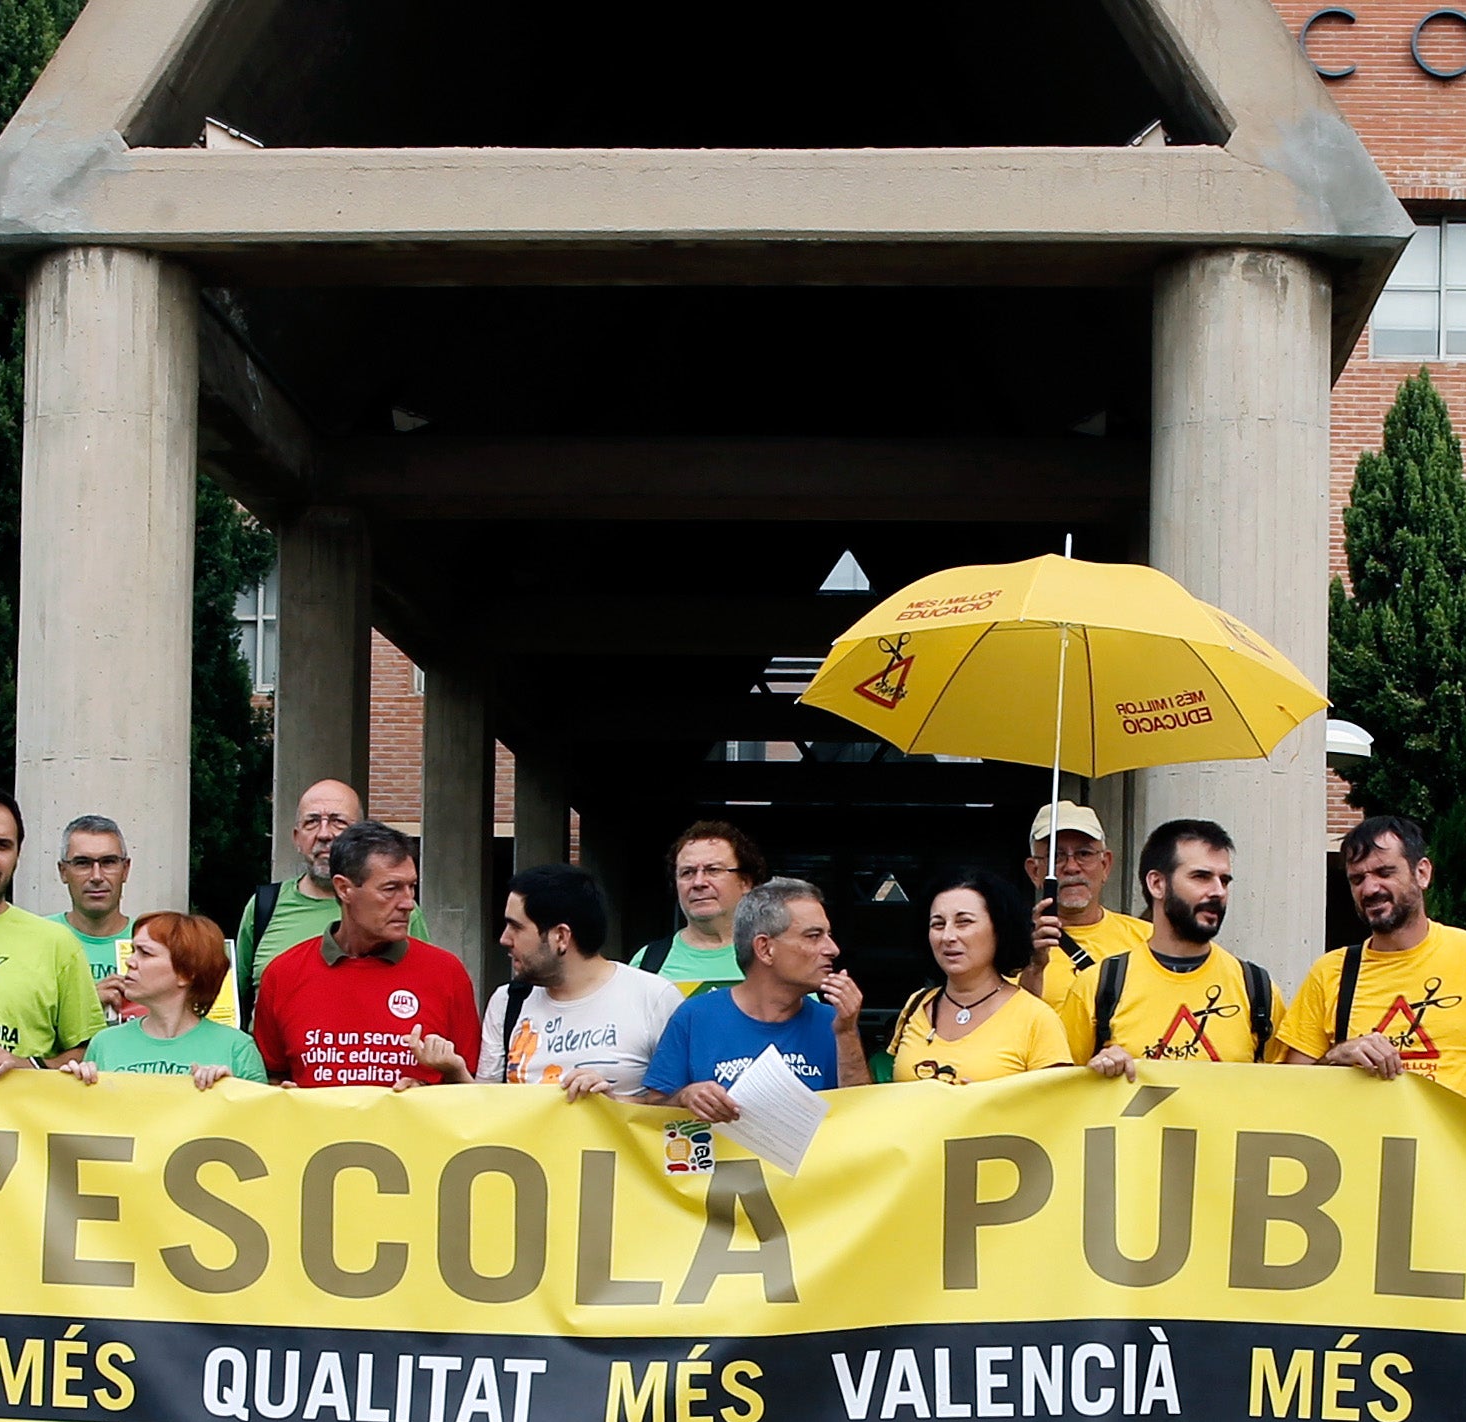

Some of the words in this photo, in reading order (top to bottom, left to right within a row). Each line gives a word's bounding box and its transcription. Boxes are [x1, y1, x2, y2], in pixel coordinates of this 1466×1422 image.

[393, 994, 414, 1008] UGT
[544, 1016, 562, 1034] en
[305, 1029, 321, 1046] Sí
[324, 1033, 333, 1045] a
[339, 1033, 358, 1045] un
[547, 1023, 617, 1053] valencià
[314, 1066, 333, 1081] de
[337, 1066, 402, 1084] qualitat
[831, 1325, 1182, 1421] VALENCIÀ
